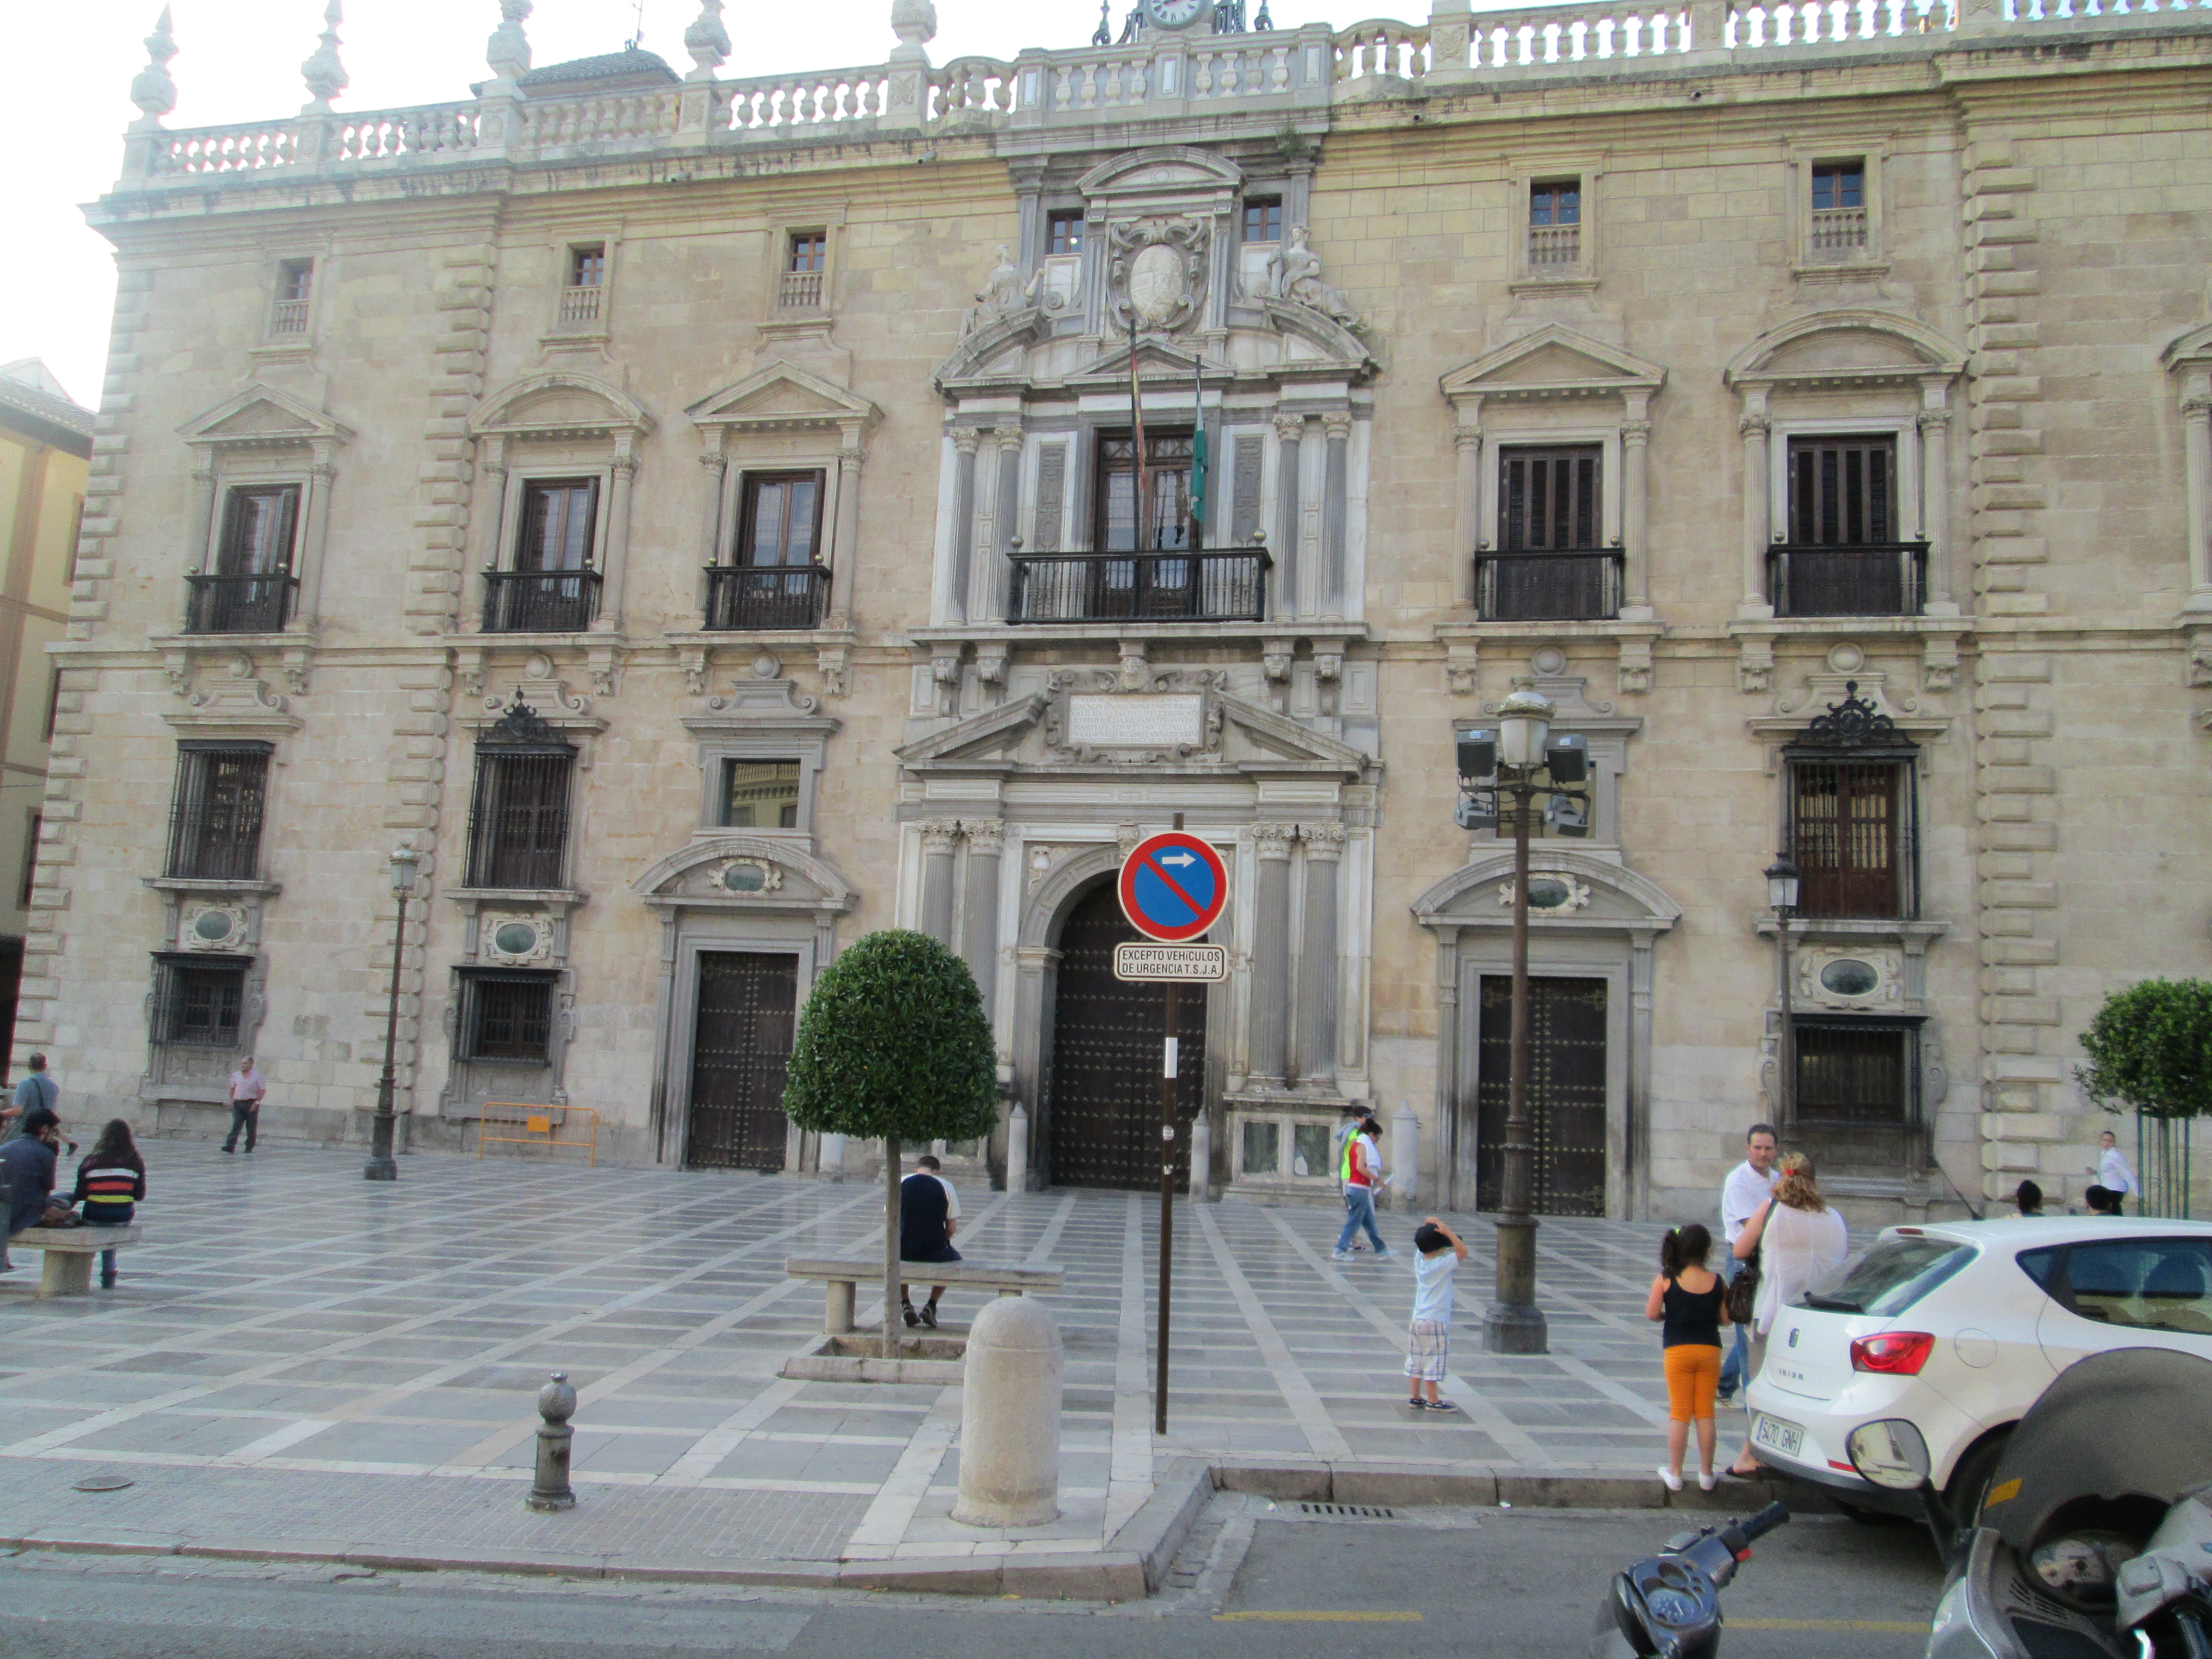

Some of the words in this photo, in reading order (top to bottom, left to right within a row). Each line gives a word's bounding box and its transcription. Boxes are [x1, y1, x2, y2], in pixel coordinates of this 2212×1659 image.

[1122, 950, 1164, 961] EXCEPTO
[1122, 963, 1134, 973] DE
[1137, 963, 1182, 974] URGENCIA
